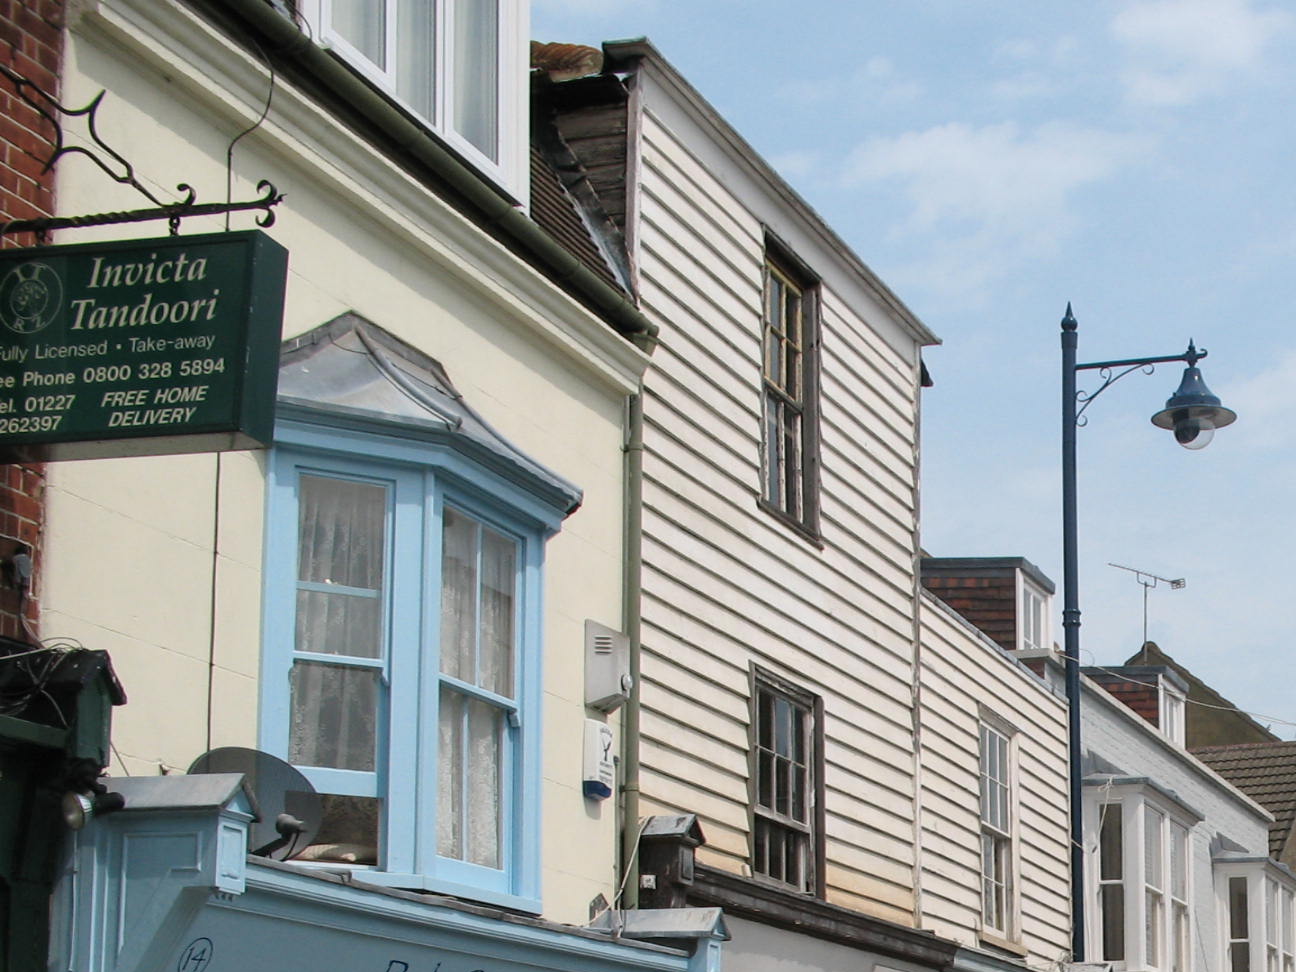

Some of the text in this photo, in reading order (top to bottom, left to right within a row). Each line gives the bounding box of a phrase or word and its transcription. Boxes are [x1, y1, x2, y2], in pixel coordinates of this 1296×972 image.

[87, 253, 208, 288] Invicta
[70, 289, 220, 330] Tandoori
[35, 339, 108, 359] Licensed
[129, 334, 215, 353] Take-away
[23, 371, 76, 387] Phone
[83, 365, 131, 383] 0800
[138, 362, 172, 379] 328
[180, 358, 225, 376] 5894
[25, 395, 76, 412] 01227
[101, 386, 209, 408] FREE HOME
[0, 415, 62, 434] 262397
[108, 407, 197, 427] DELIVERY
[182, 947, 207, 972] 14
